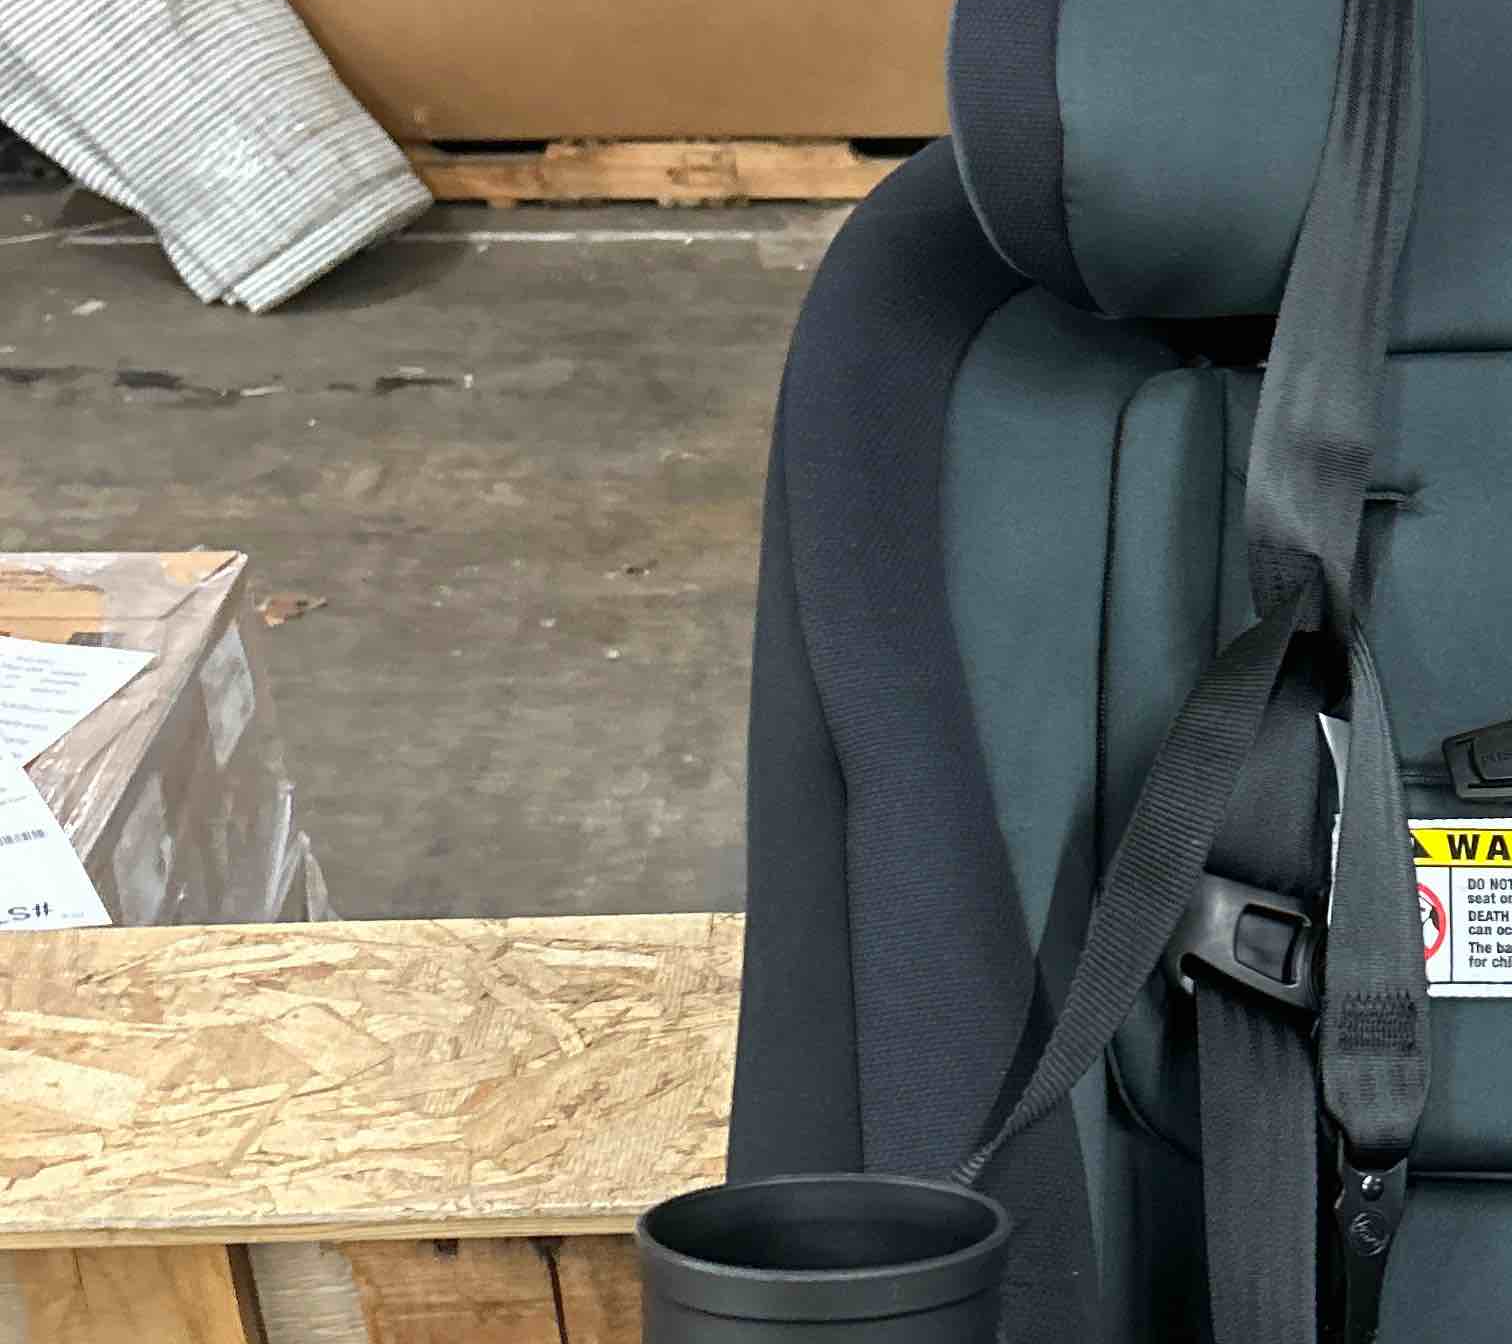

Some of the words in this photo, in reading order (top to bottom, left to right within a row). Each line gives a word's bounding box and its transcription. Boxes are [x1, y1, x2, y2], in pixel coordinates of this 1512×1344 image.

[1468, 878, 1485, 890] DO
[1467, 893, 1496, 904] seat
[1468, 910, 1509, 921] DEATH
[1468, 926, 1492, 935] can
[1468, 941, 1492, 953] The
[1468, 955, 1487, 967] for
